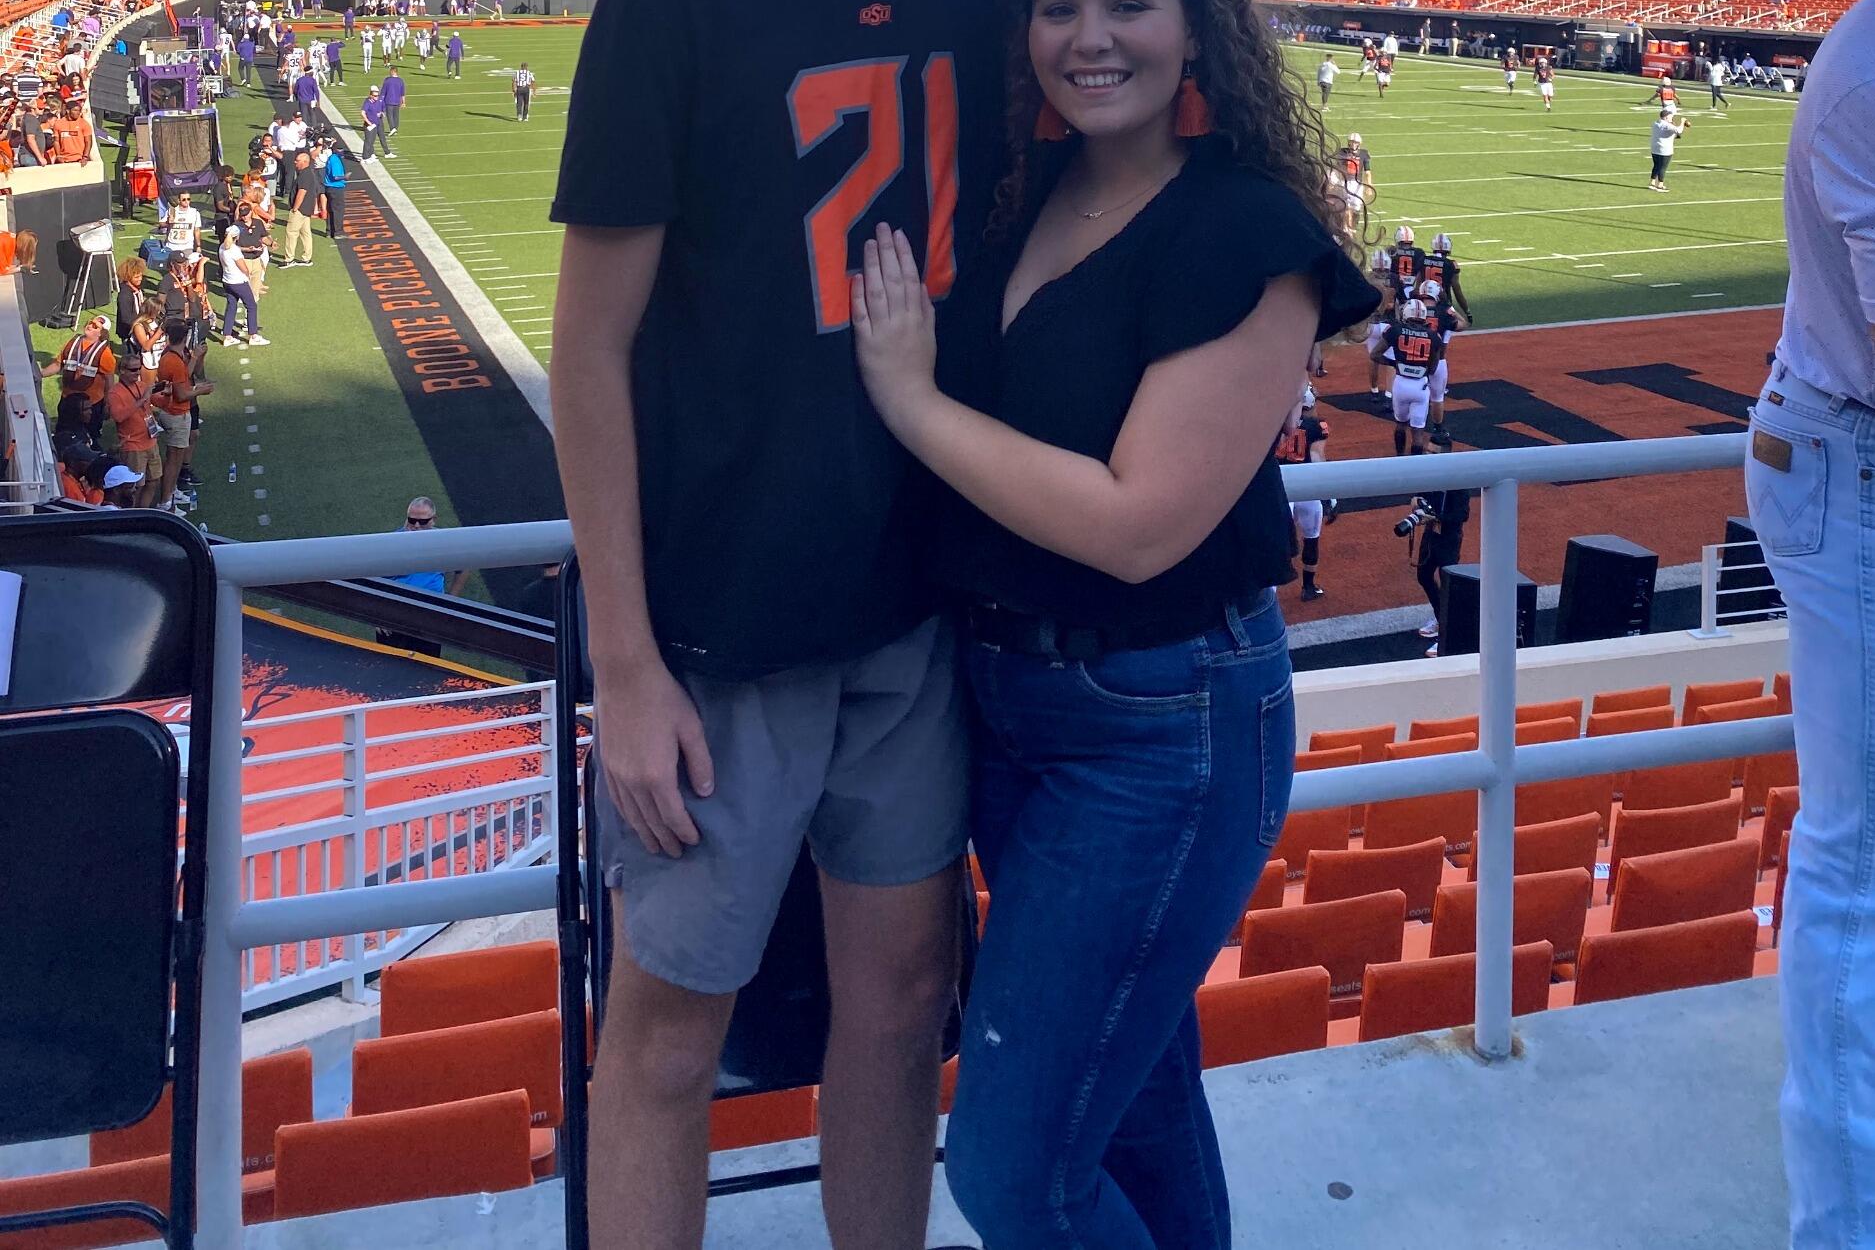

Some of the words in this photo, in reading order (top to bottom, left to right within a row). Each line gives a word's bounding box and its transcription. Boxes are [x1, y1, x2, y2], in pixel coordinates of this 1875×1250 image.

[860, 3, 891, 25] OSU
[786, 51, 959, 334] 21
[352, 243, 441, 312] PICKENS
[391, 315, 493, 395] BOONE
[1398, 334, 1432, 362] 40
